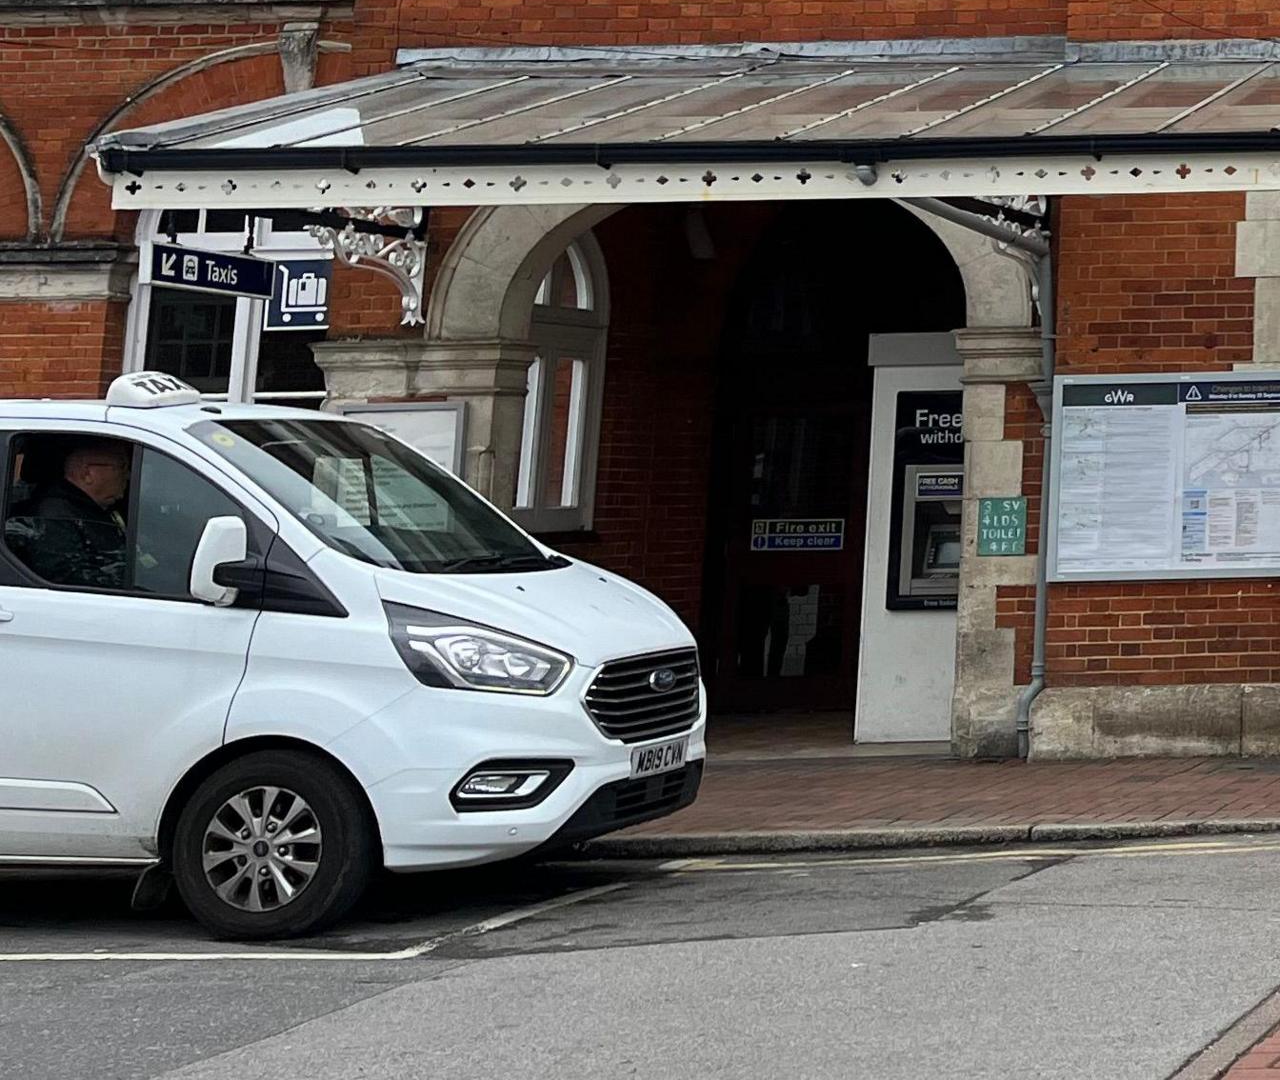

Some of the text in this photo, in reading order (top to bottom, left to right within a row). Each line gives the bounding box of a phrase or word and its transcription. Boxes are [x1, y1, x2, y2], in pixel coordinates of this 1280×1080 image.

[205, 260, 238, 285] Taxis
[131, 377, 189, 395] TAX
[1105, 389, 1134, 404] GWR
[915, 409, 963, 427] Free
[1003, 501, 1020, 511] SV
[776, 522, 836, 533] Fire exit
[982, 528, 1020, 539] TOILET
[775, 536, 835, 547] Keep clear
